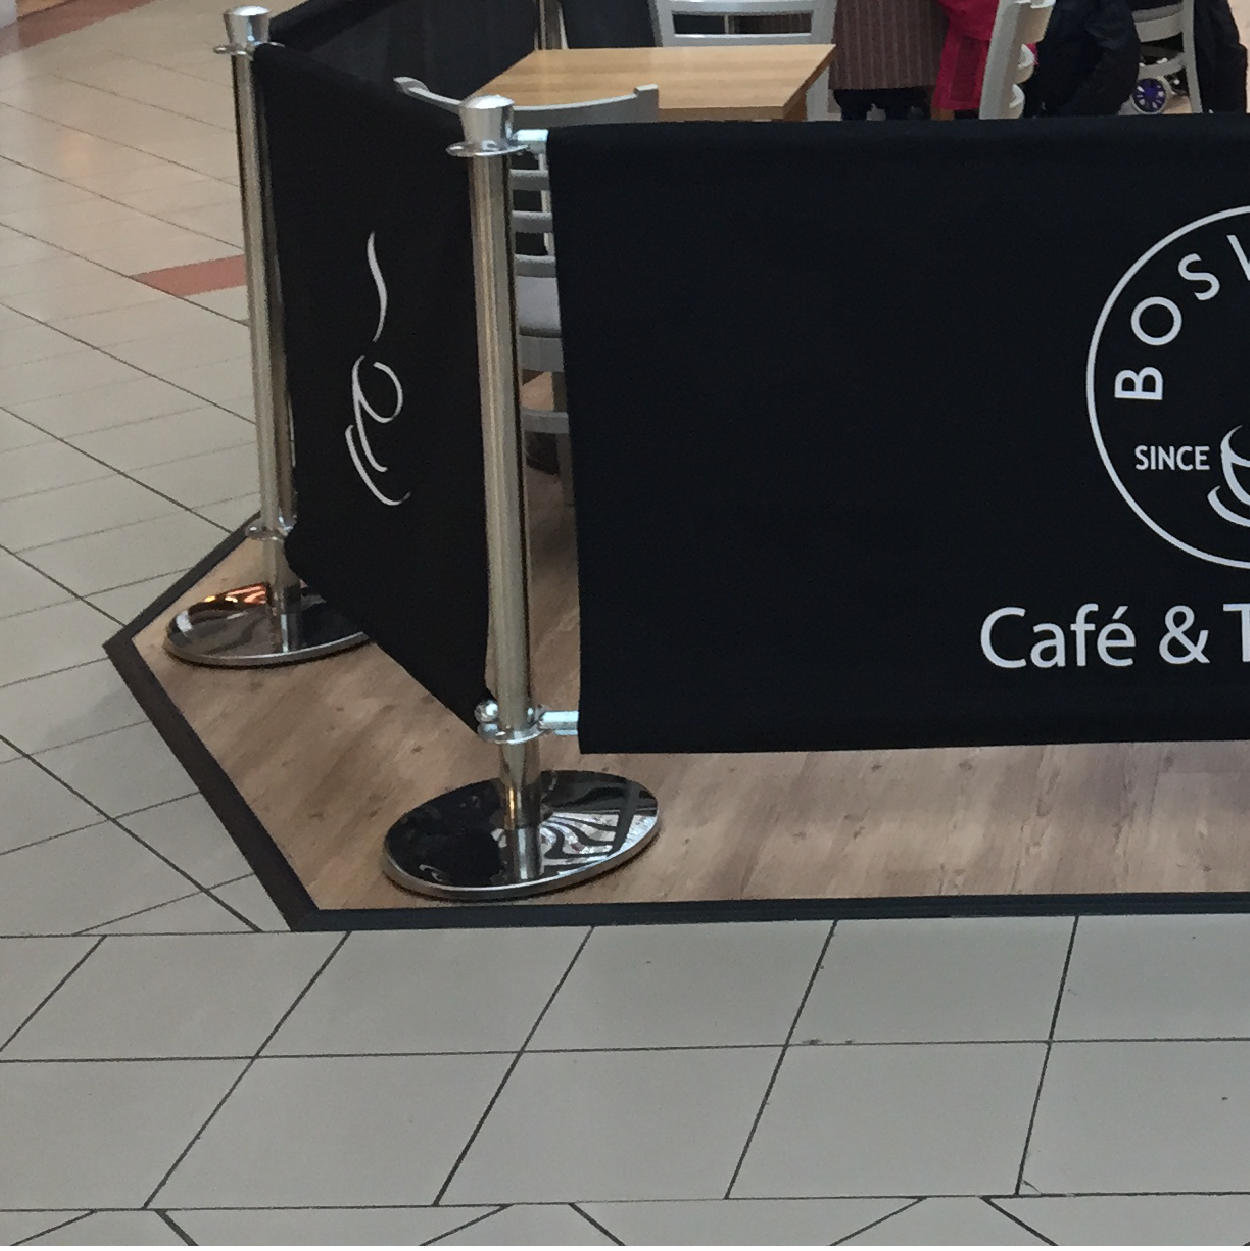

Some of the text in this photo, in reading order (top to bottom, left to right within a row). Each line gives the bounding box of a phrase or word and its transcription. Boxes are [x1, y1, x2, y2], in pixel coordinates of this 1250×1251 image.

[1135, 444, 1211, 472] SINCE
[980, 603, 1137, 668] Café
[1158, 605, 1210, 664] &
